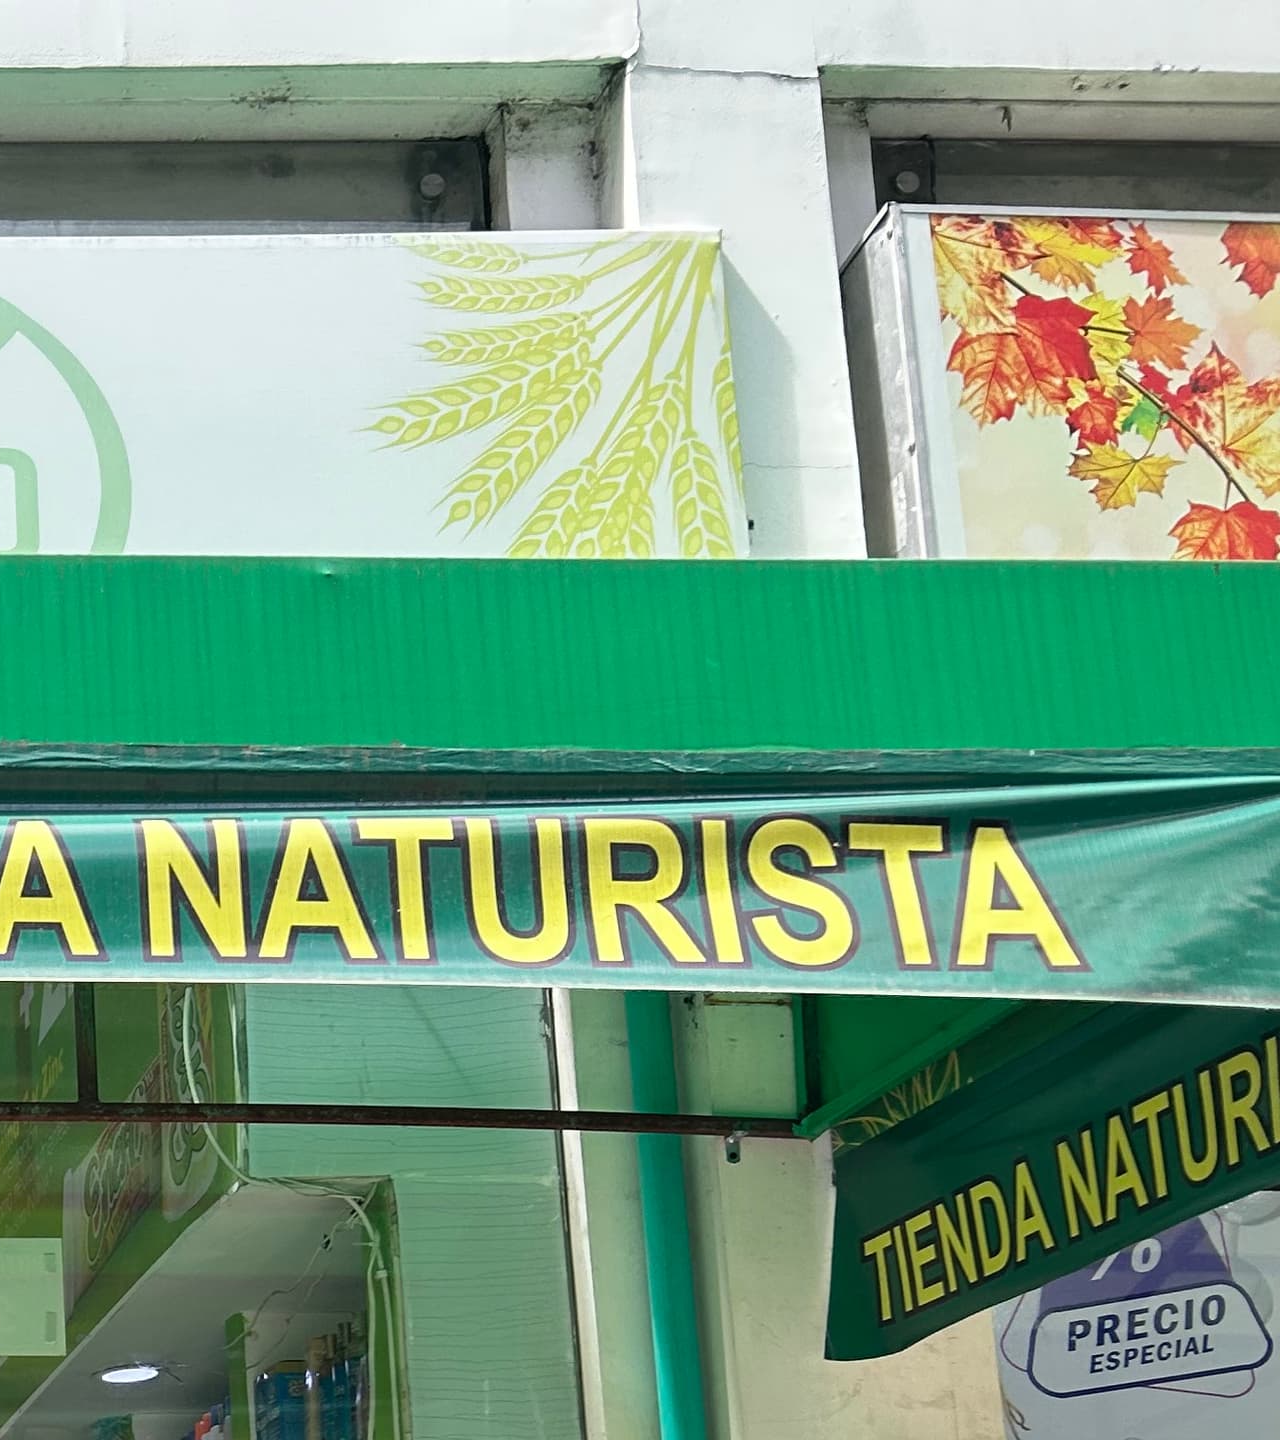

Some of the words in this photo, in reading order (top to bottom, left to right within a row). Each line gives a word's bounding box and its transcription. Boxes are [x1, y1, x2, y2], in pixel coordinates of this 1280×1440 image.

[135, 814, 1090, 972] NATURISTA
[862, 1160, 1057, 1323] TIENDA
[1054, 1034, 1280, 1240] NATURI
[1065, 1293, 1227, 1353] PRECIO
[1088, 1333, 1216, 1375] ESPECIAL
